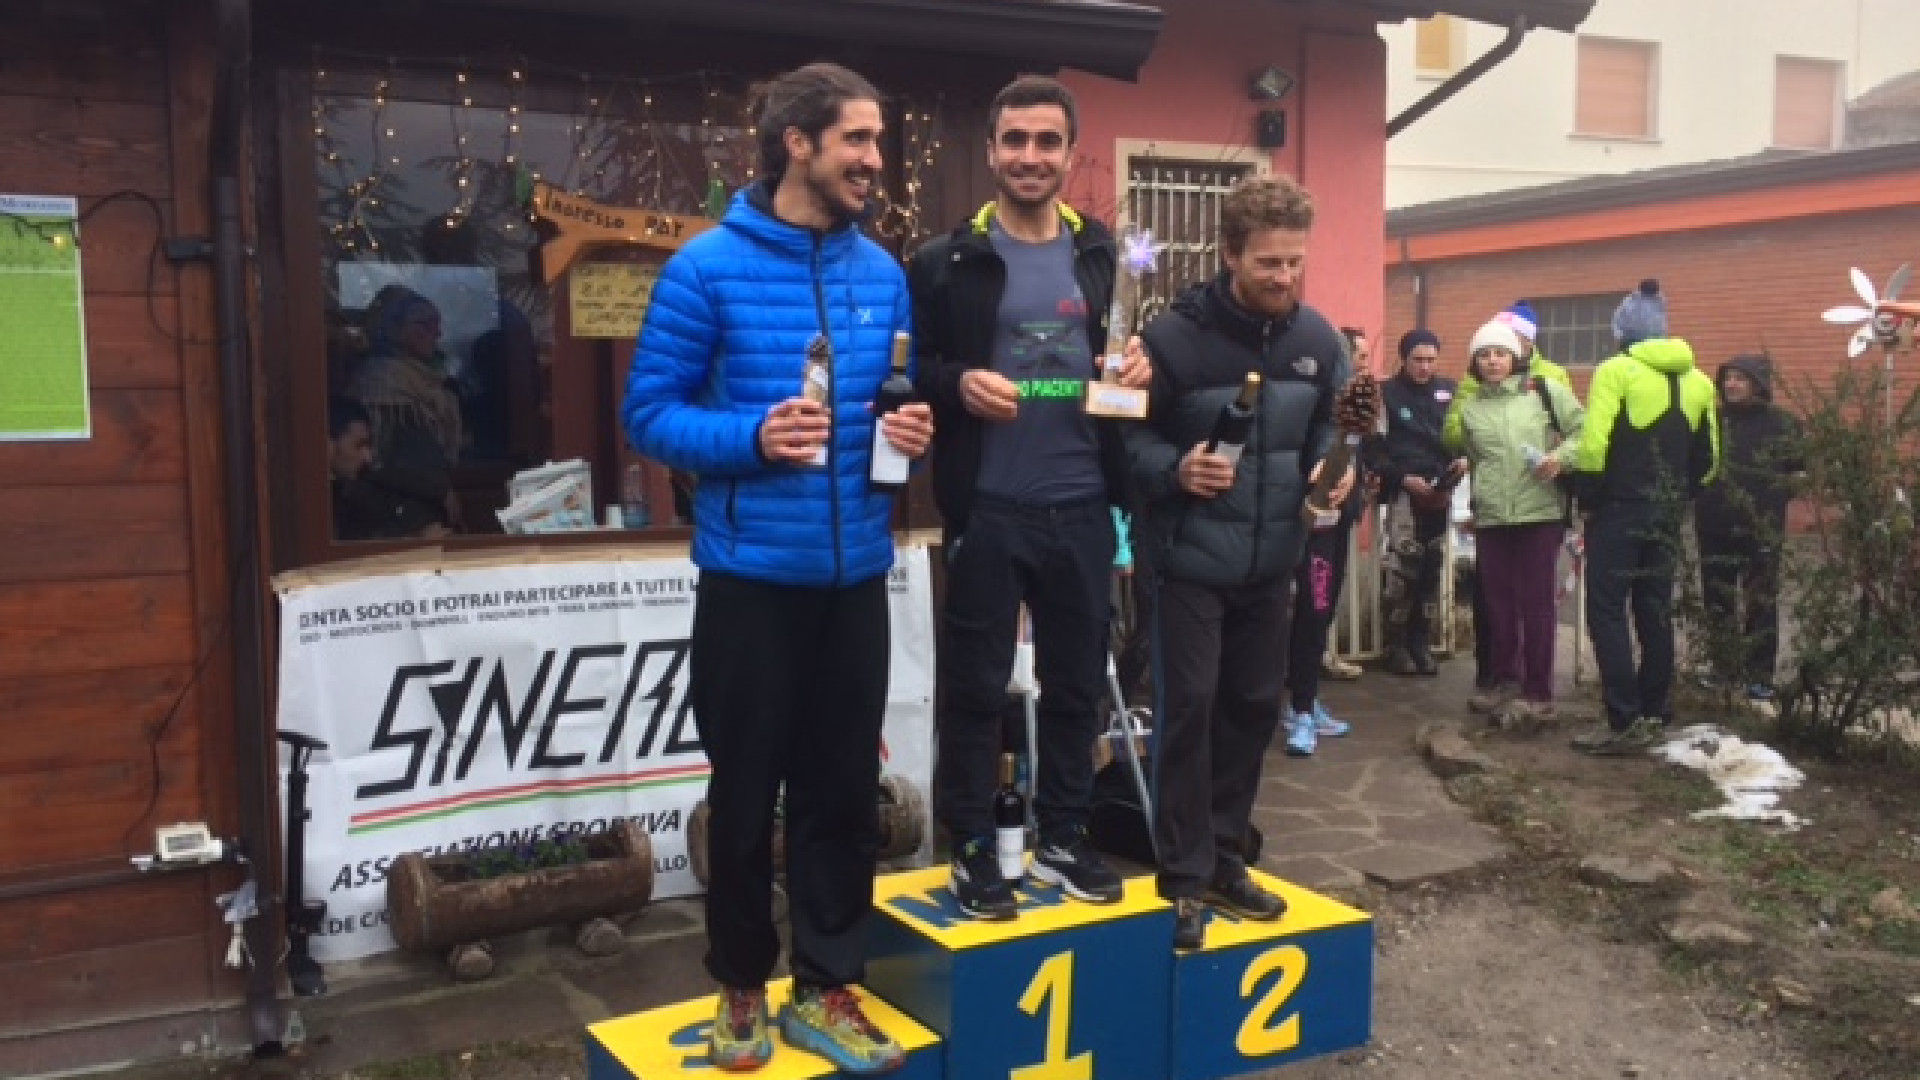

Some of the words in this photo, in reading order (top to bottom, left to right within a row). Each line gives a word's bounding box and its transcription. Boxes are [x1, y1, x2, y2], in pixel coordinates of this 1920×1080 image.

[356, 602, 414, 620] SOCIO
[419, 600, 428, 612] E
[434, 593, 500, 611] POTRAI
[503, 583, 616, 604] PARTECIPARE
[621, 581, 634, 595] A
[635, 578, 684, 595] TUTTE
[1009, 950, 1094, 1080] 1
[1236, 945, 1308, 1057] 2
